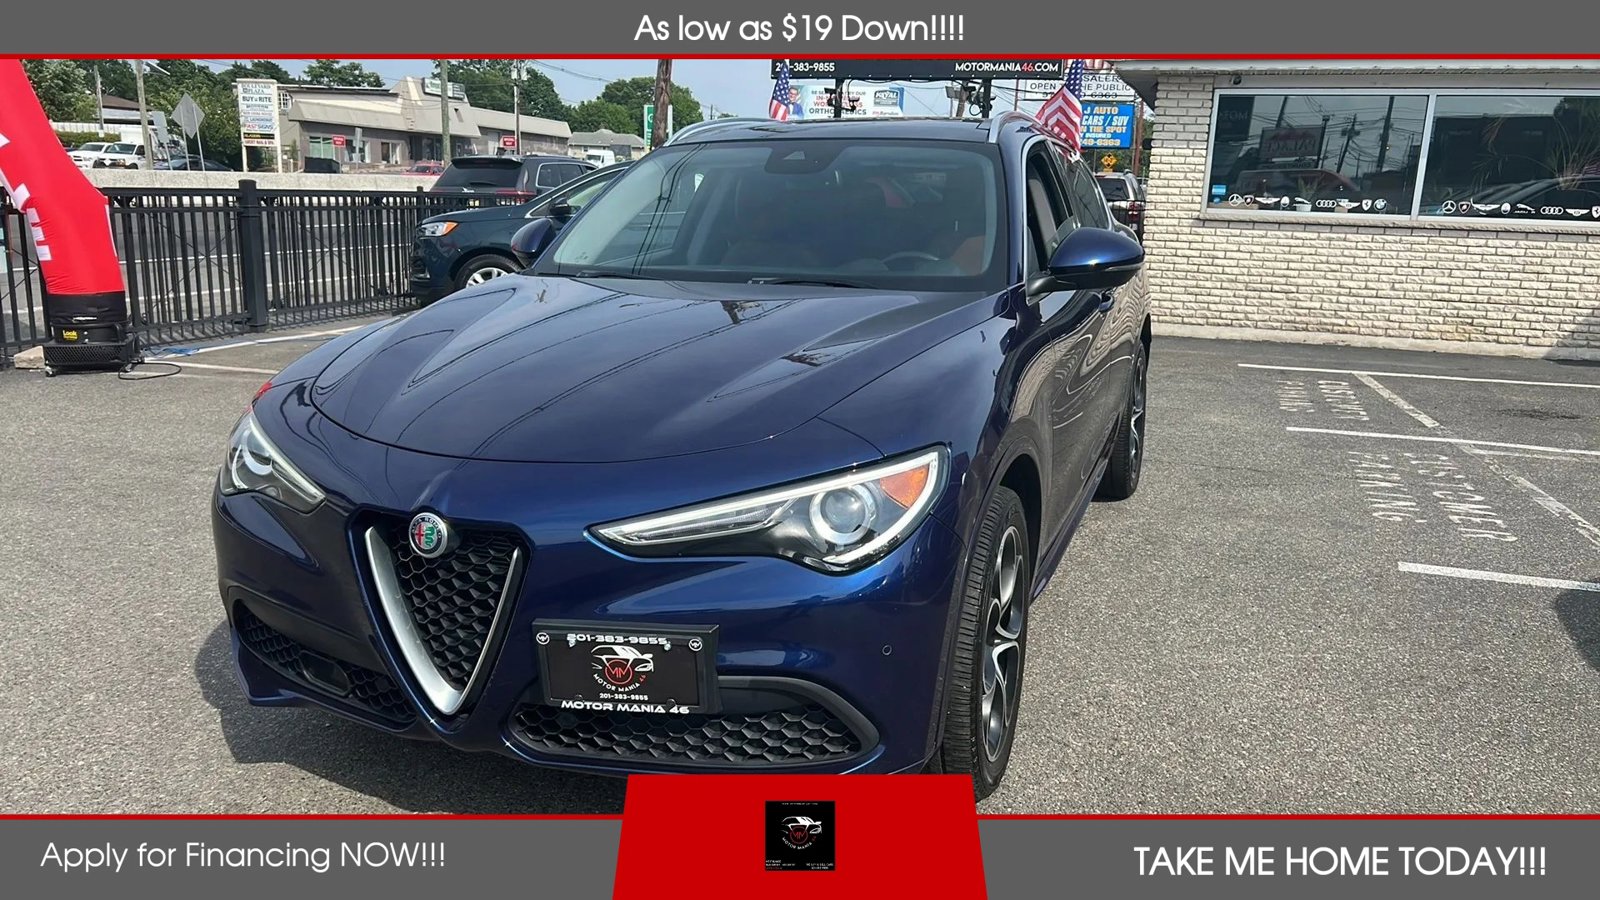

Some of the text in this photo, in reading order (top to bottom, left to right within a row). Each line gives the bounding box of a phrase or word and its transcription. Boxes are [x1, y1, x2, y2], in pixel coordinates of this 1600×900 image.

[775, 62, 835, 72] 2-383-9855
[954, 62, 1059, 72] MOTORMANIA46.COM
[1030, 82, 1056, 90] OPEN
[1095, 83, 1131, 91] PUBLIC
[1093, 106, 1119, 114] AUTO
[1082, 115, 1104, 125] CARS
[1112, 116, 1130, 126] SUV
[1347, 451, 1428, 523] PARKING
[1402, 453, 1518, 542] CUSTOMER
[566, 633, 668, 646] 201-383-9855
[593, 674, 616, 692] MOTOR
[618, 682, 641, 692] MANIA
[599, 692, 649, 701] 201-383-9855
[561, 700, 690, 714] MOTOR MANIA 46
